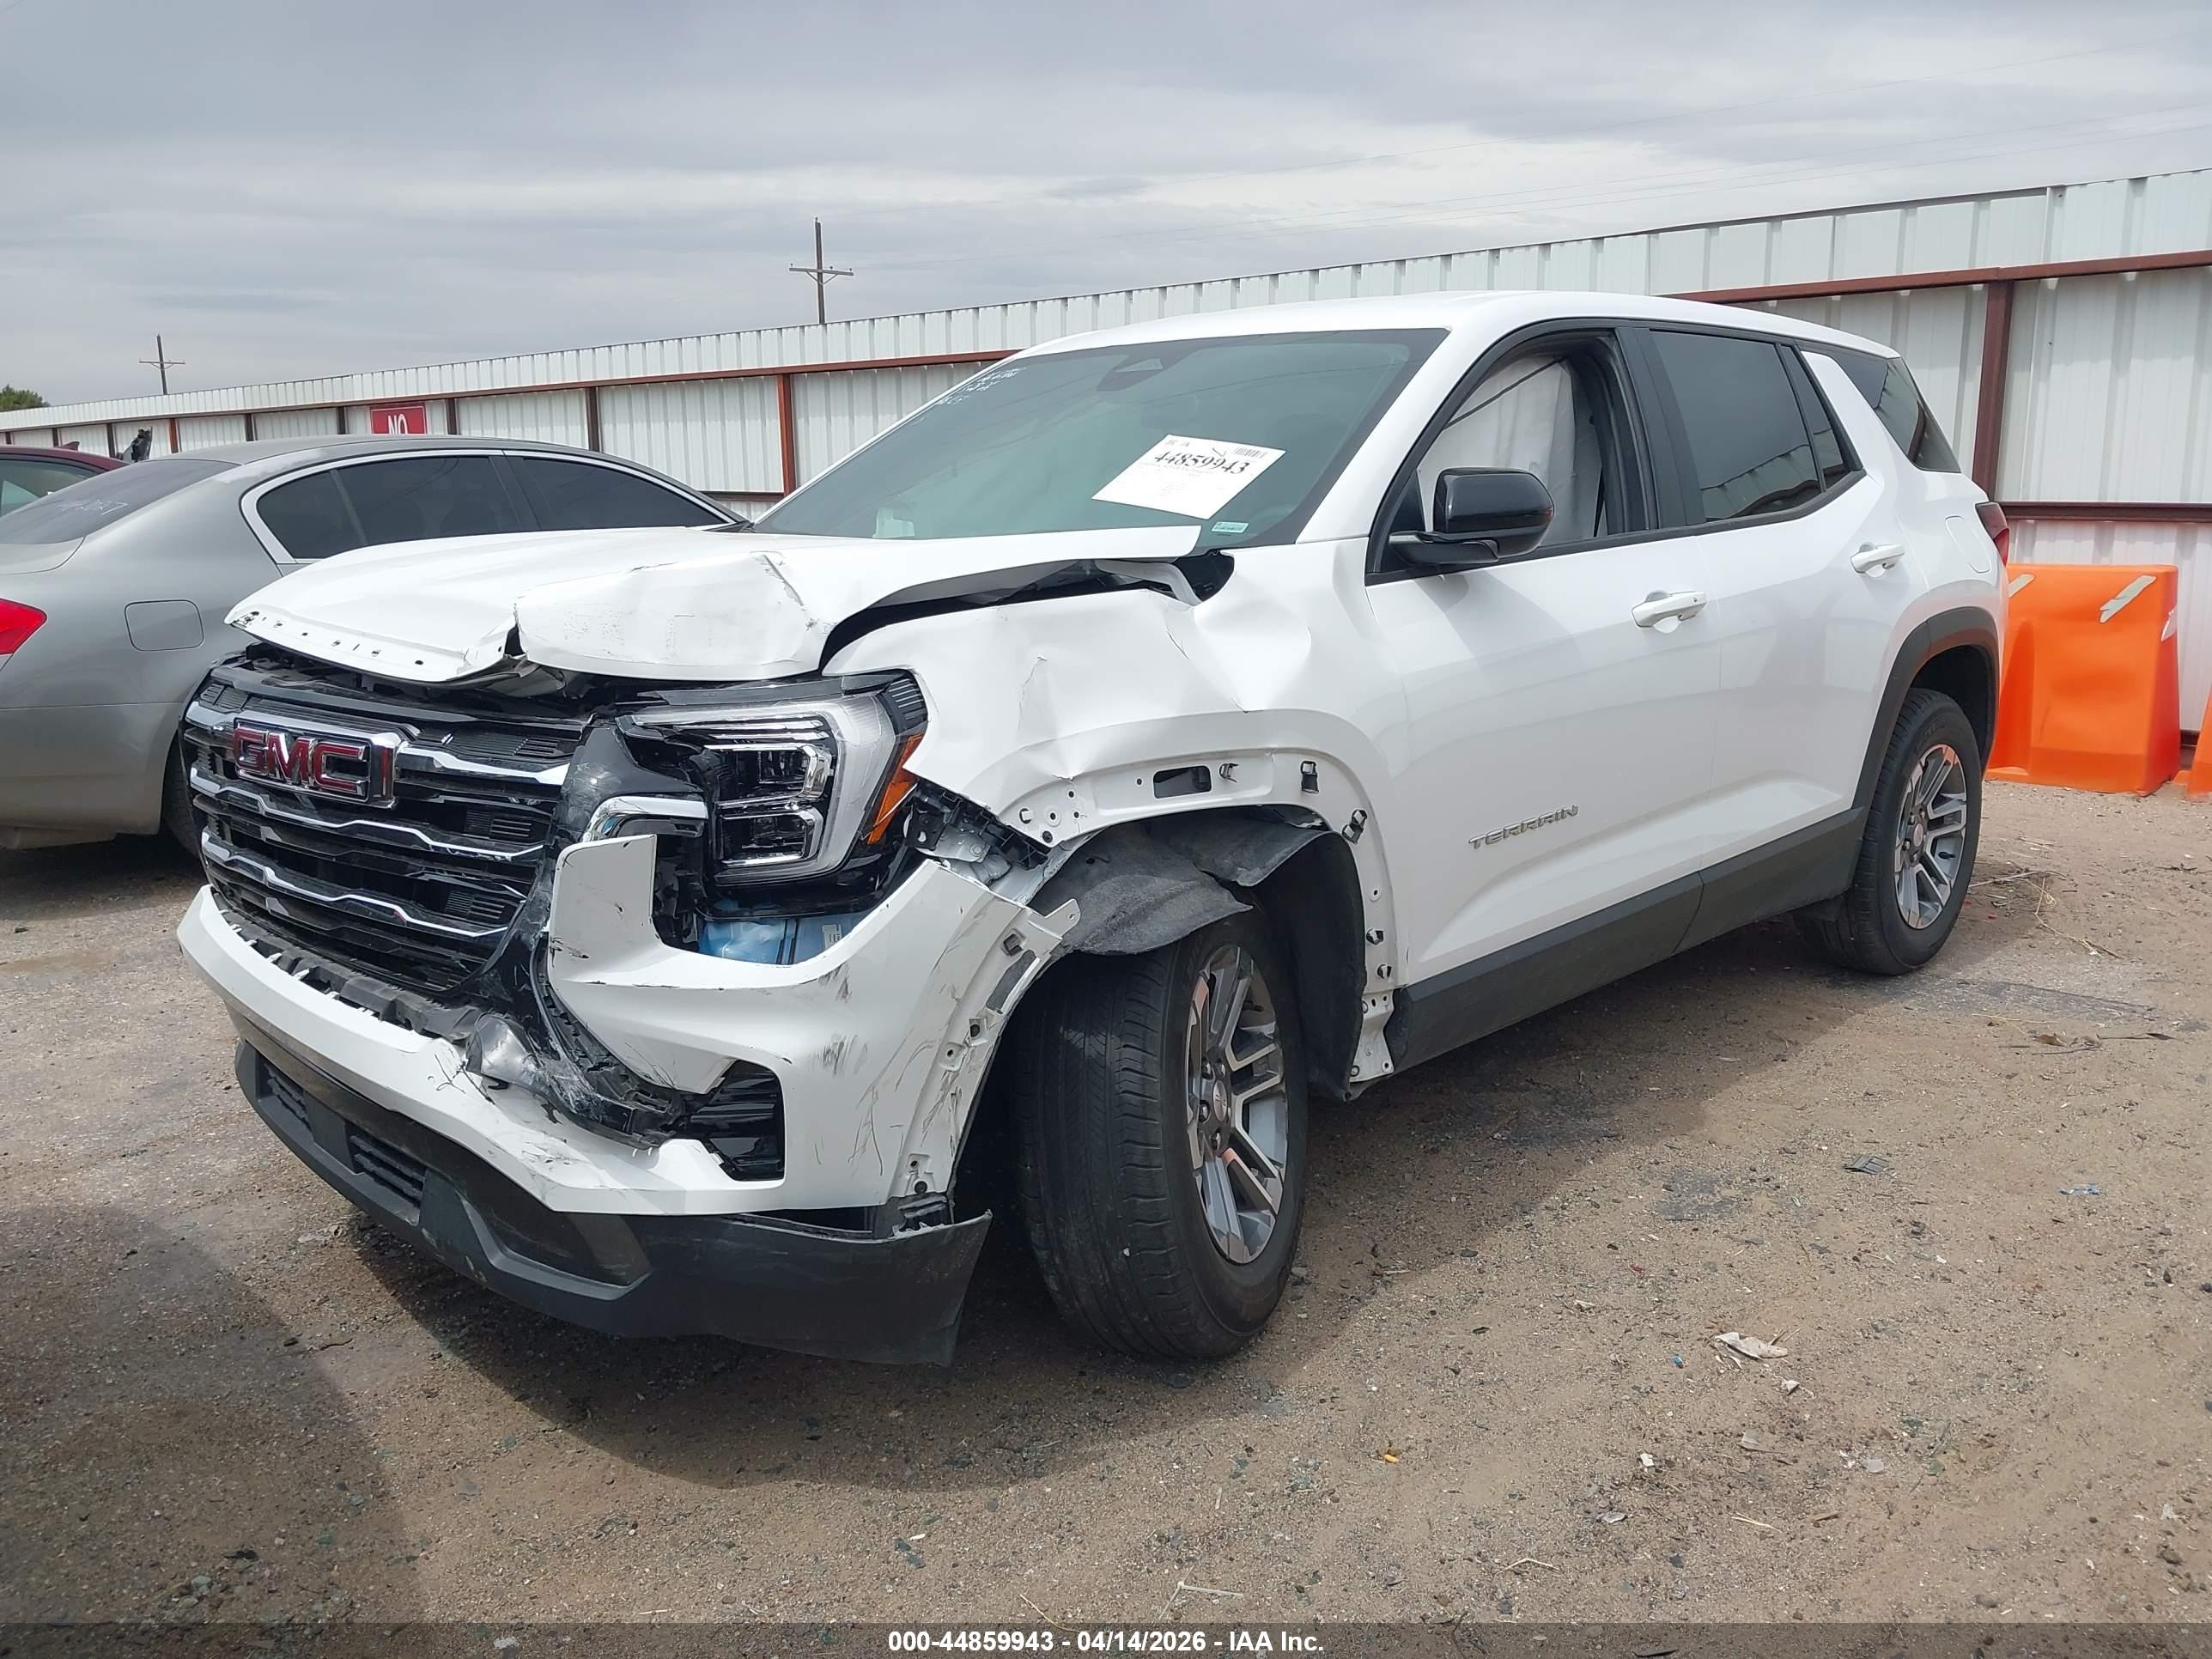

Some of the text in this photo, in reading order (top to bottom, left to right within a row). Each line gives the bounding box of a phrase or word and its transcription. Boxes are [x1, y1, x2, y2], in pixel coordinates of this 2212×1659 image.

[1154, 451, 1250, 474] 44859943
[233, 726, 368, 796] GMC
[1468, 804, 1579, 849] TERRAIN
